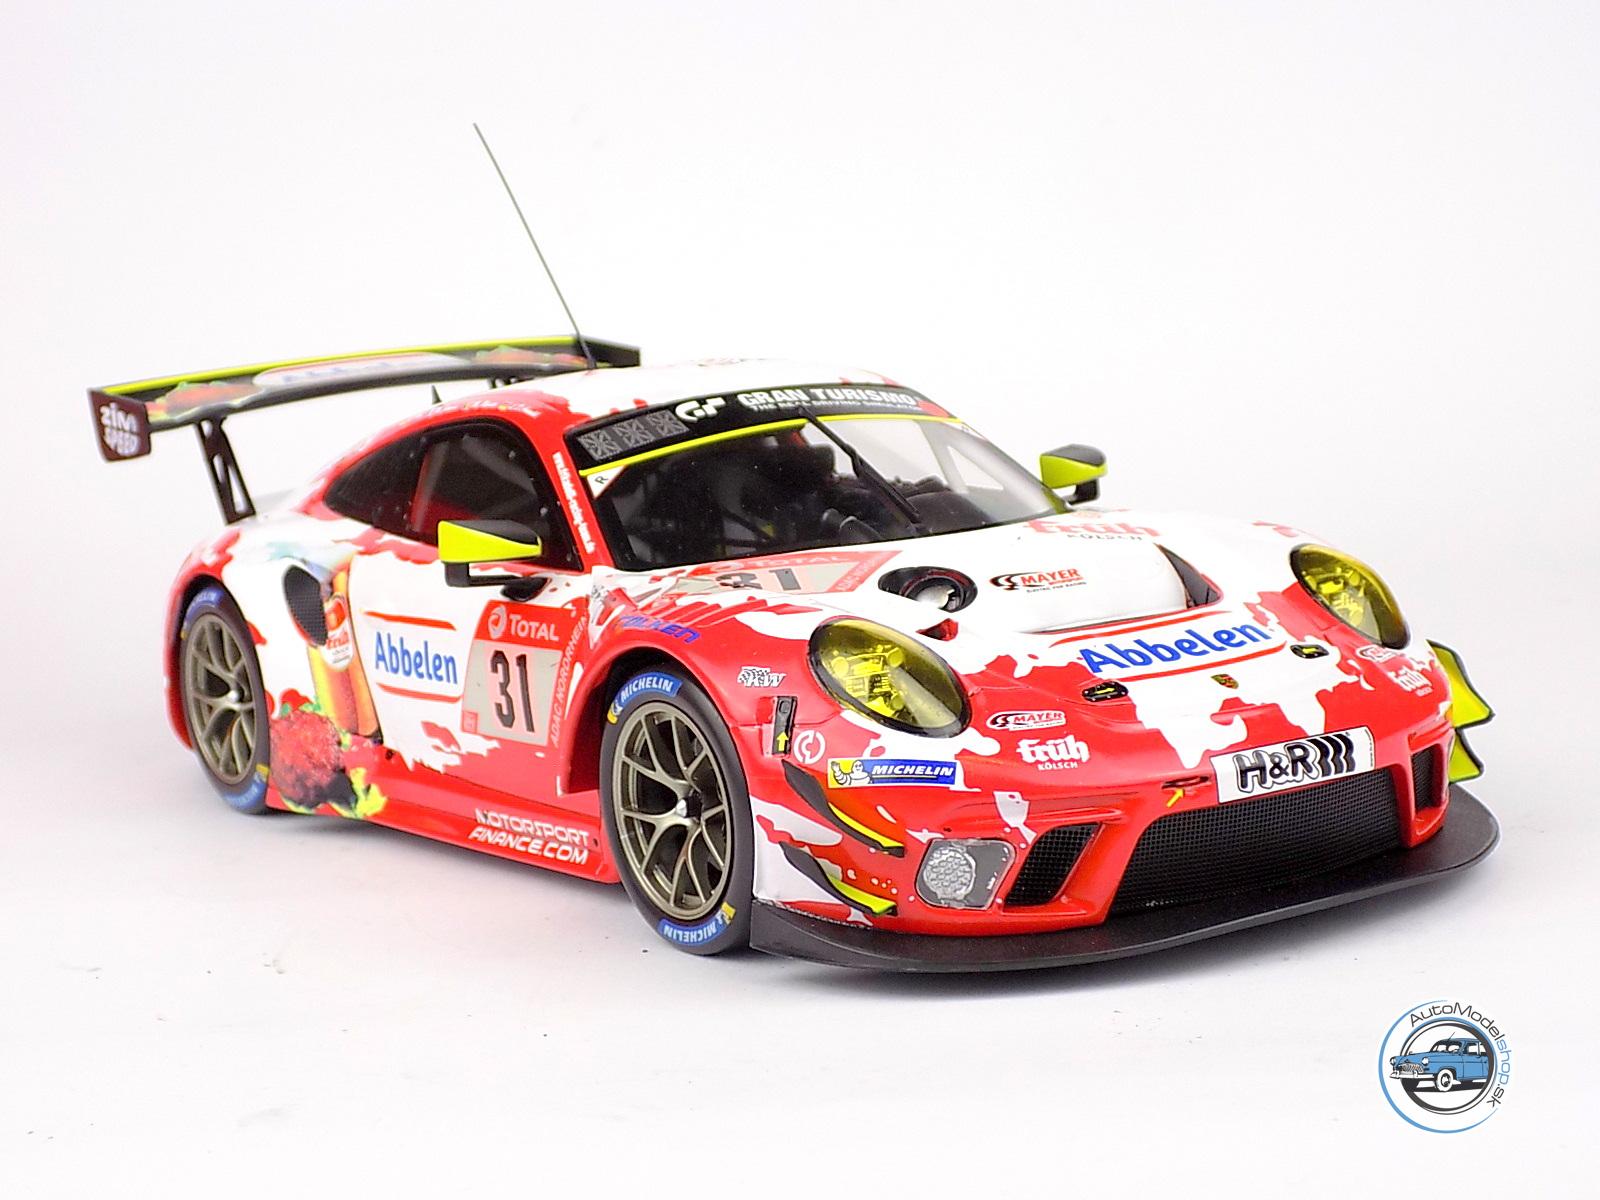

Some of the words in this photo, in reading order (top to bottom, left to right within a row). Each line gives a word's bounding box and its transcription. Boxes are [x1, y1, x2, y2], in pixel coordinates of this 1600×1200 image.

[737, 388, 811, 407] GRAN
[809, 388, 918, 406] TURISMO
[1020, 568, 1081, 585] MAYER
[508, 613, 560, 641] TOTAL
[375, 631, 458, 684] Abbelen
[1079, 623, 1273, 674] Abbelen
[490, 650, 535, 733] 31
[620, 676, 674, 702] MICHELIN
[1013, 712, 1063, 723] MAYER
[870, 764, 955, 777] MICHELIN
[474, 808, 590, 847] MOTORSPORT
[468, 826, 589, 865] FINANCE.COM
[663, 921, 717, 943] MICHELIN
